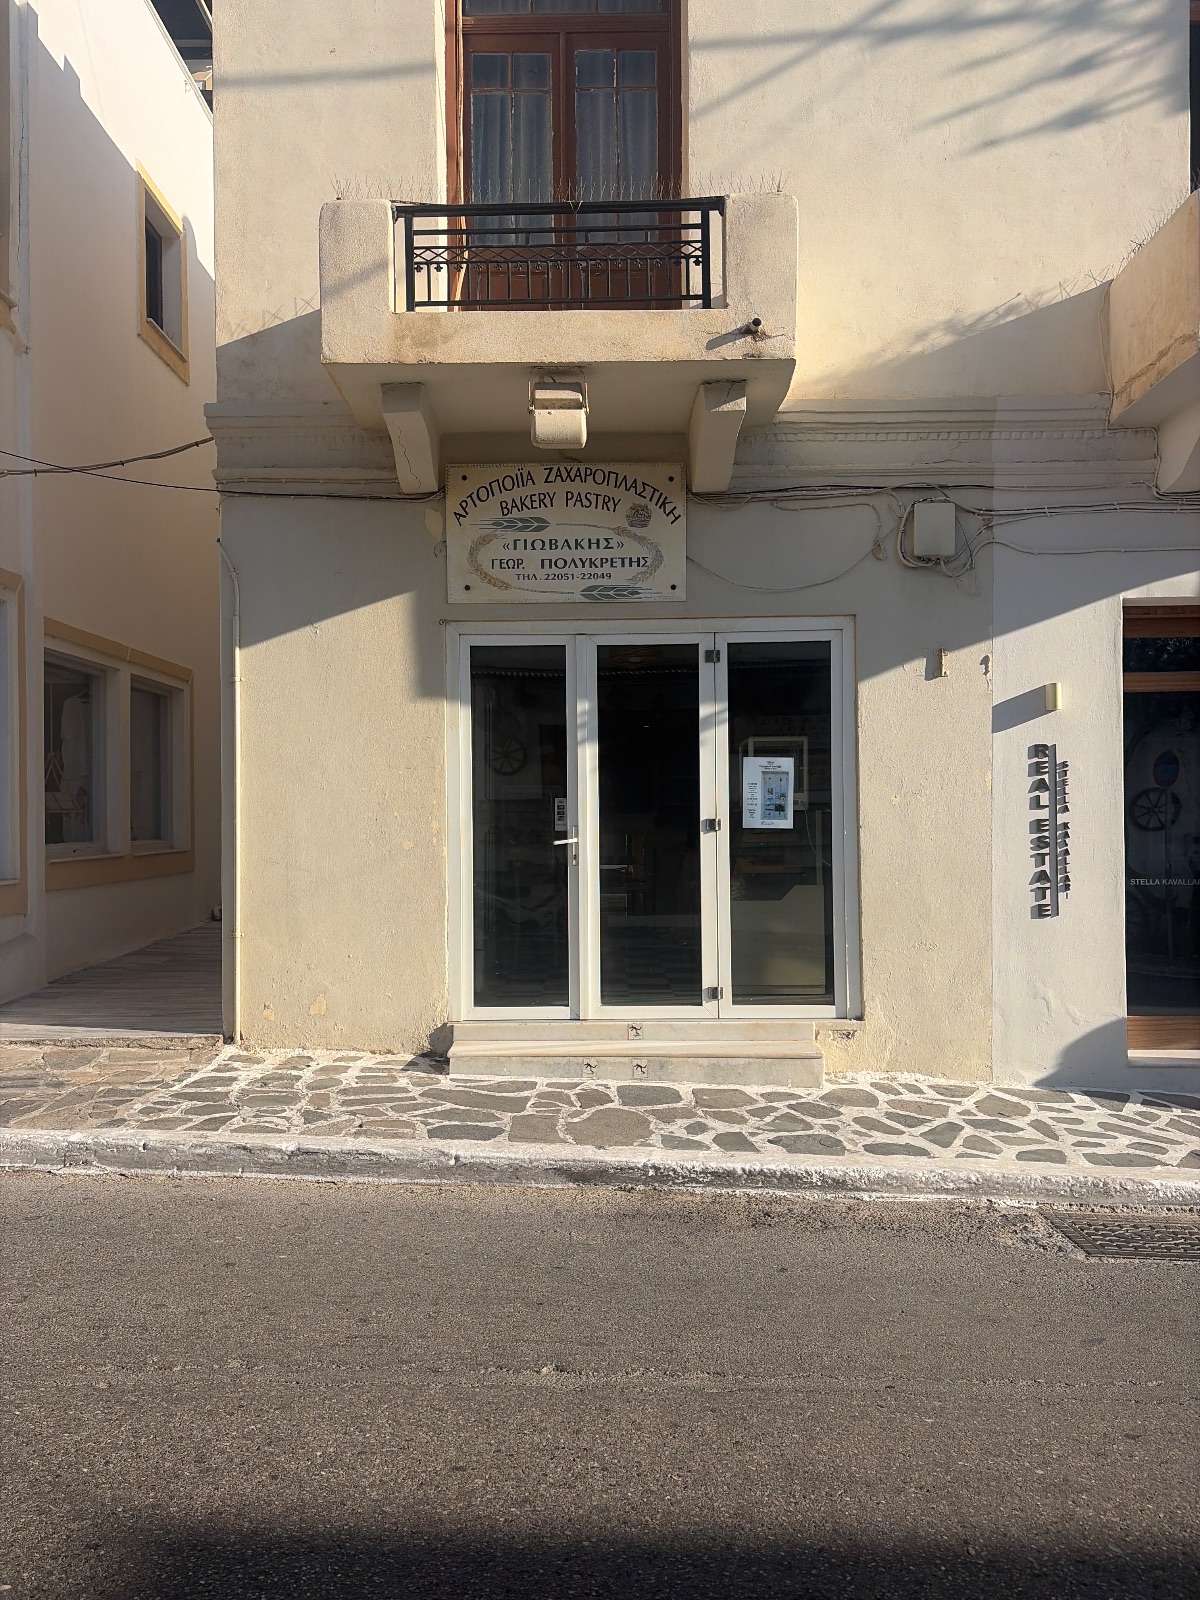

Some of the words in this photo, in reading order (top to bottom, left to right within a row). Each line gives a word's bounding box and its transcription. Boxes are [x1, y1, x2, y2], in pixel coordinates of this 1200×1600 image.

[500, 491, 556, 516] BAKERY
[565, 490, 621, 513] PASTRY
[543, 466, 681, 525] ΖΑΧΑΡΟΠΛΑΣΤΙΚΗ
[491, 558, 525, 569] ΓΕΩΡ.
[540, 556, 649, 569] ΠΟΛΥΚΡΕΤΗΣ
[544, 572, 612, 581] 22051-22049
[1030, 744, 1050, 810] REAL
[1031, 819, 1052, 919] ESTATE
[1130, 878, 1160, 886] STELLA
